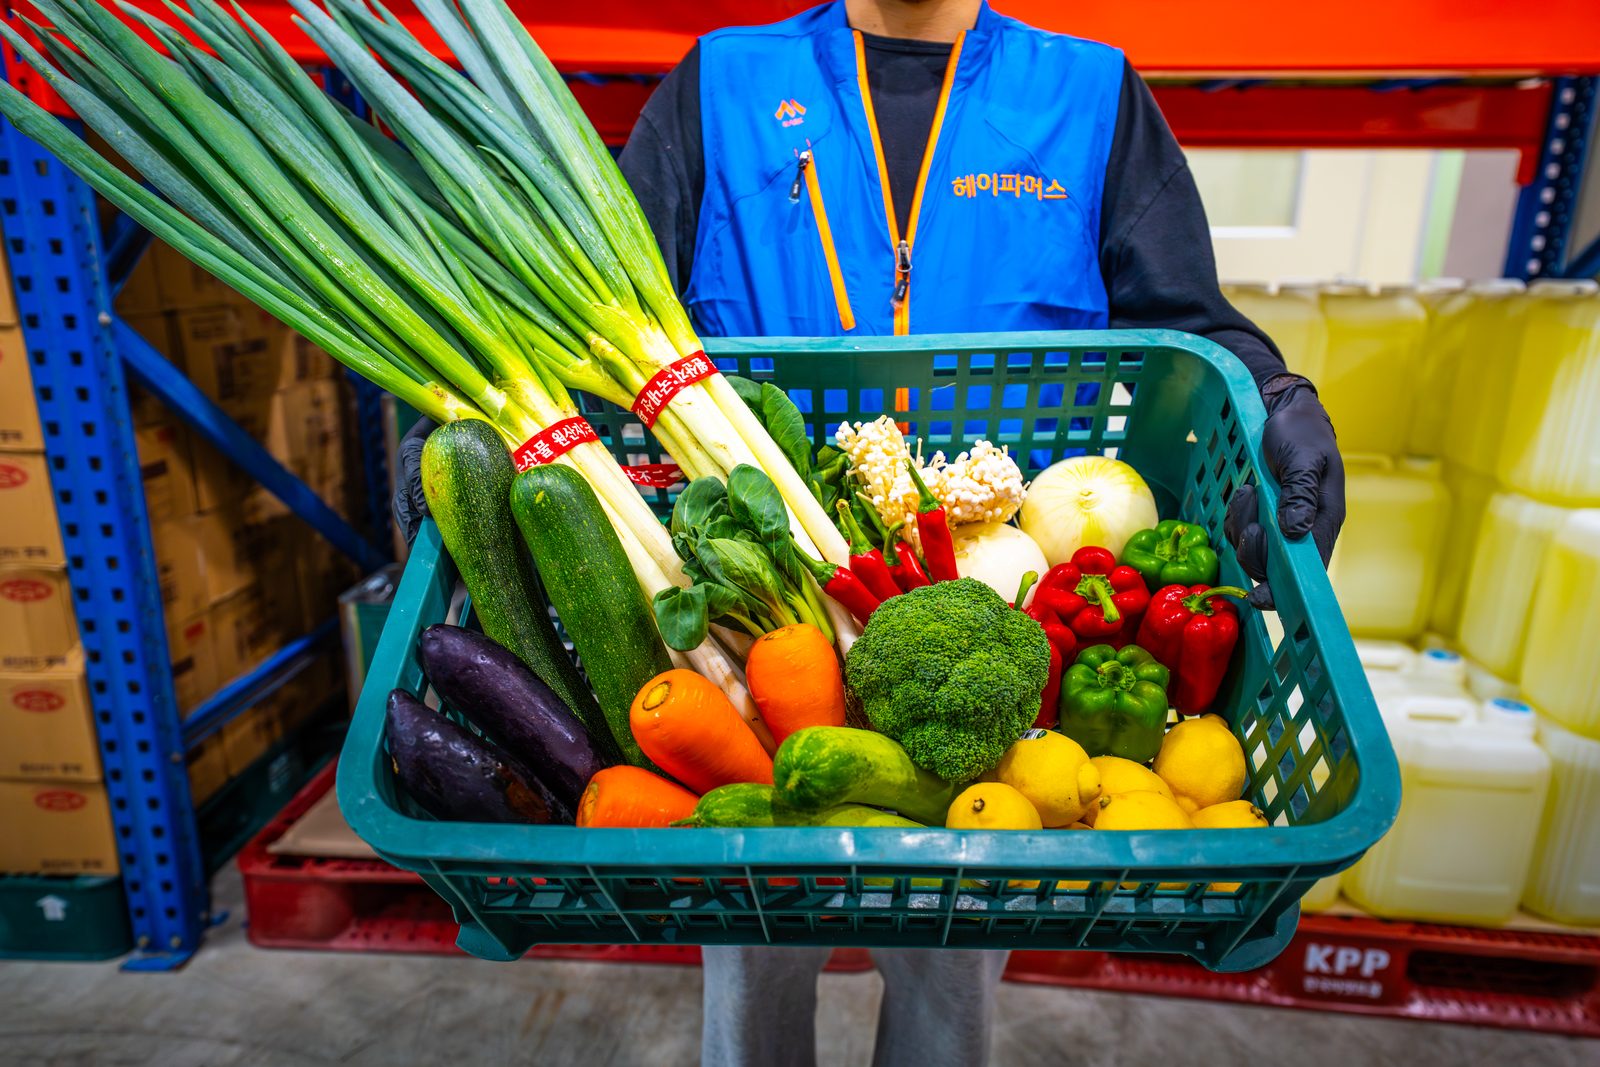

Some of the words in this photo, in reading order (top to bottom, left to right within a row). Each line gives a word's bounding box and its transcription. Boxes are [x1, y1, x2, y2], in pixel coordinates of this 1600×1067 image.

[951, 172, 1068, 201] 헤이파머스
[641, 357, 709, 415] 원산지:국내산
[1305, 943, 1391, 977] KPP
